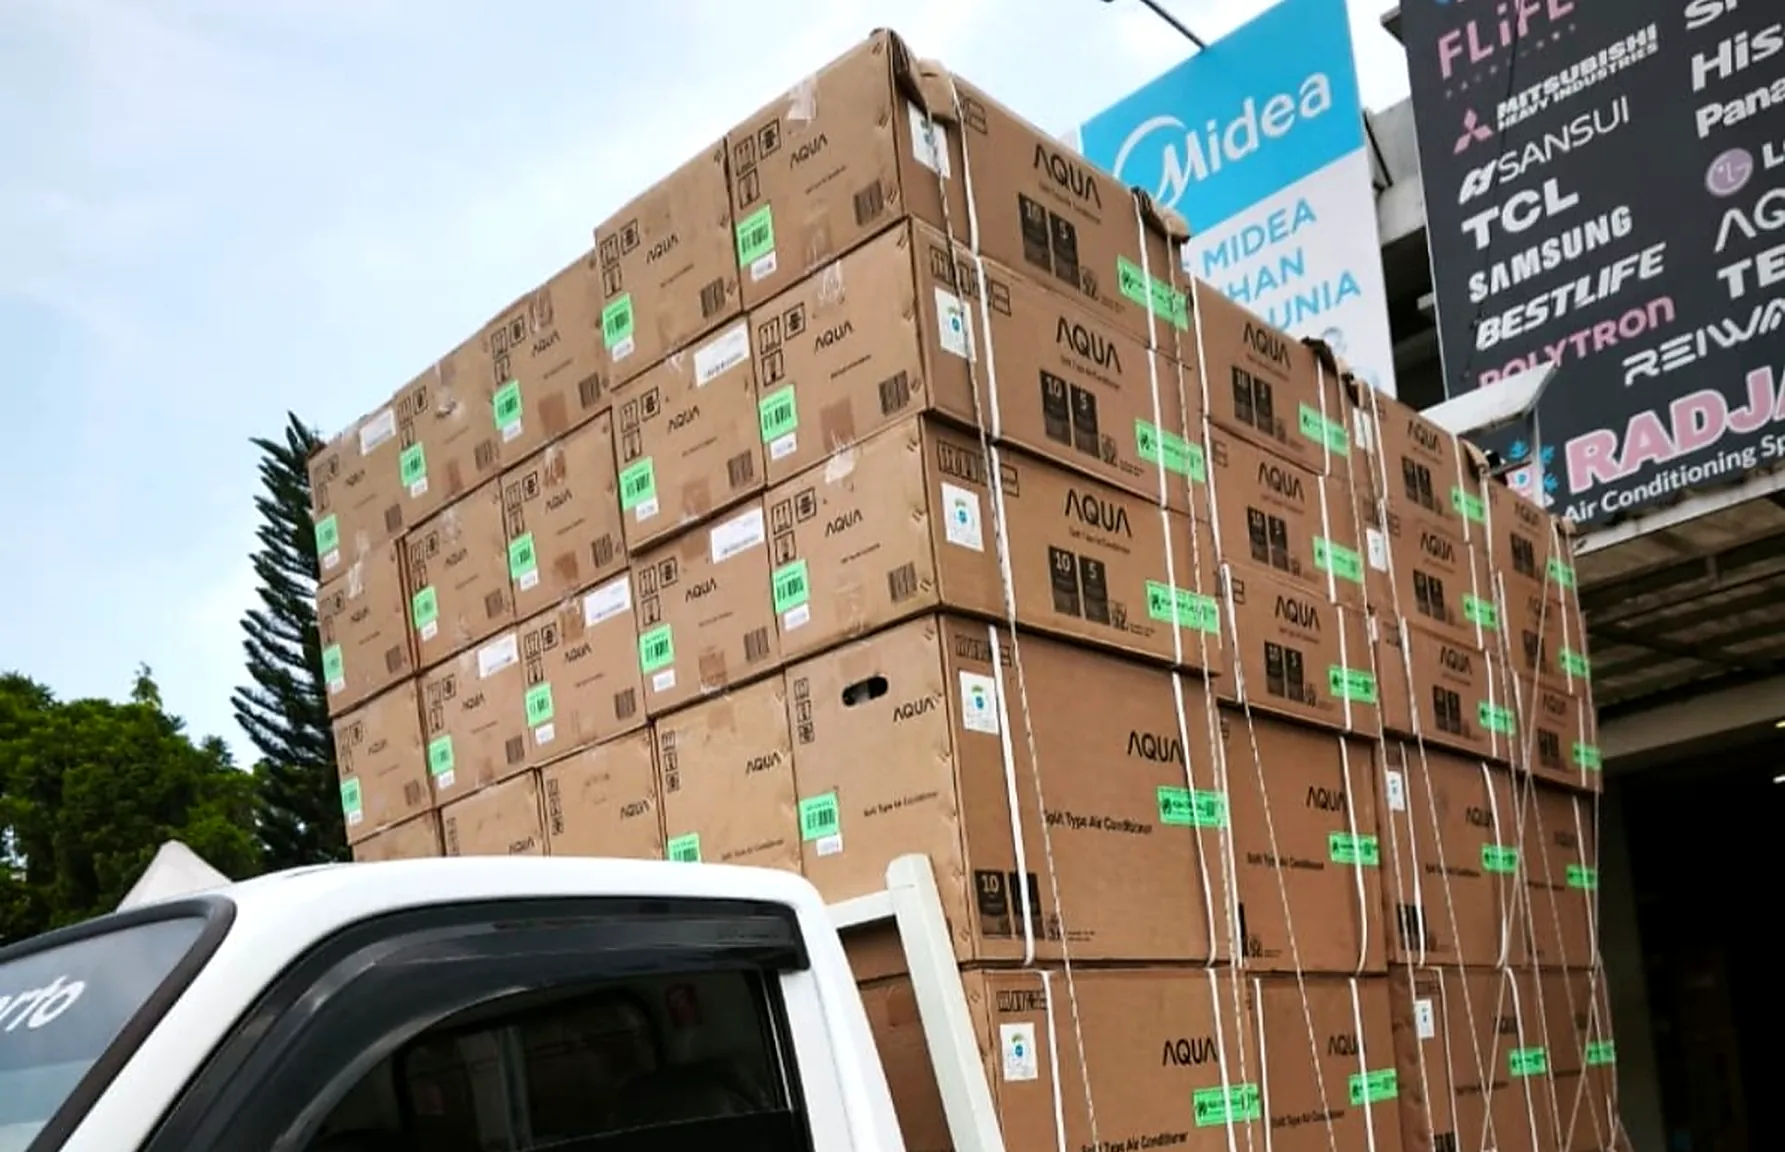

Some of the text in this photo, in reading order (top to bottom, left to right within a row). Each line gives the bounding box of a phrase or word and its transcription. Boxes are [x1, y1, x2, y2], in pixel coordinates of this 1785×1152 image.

[1684, 0, 1738, 30] S
[1497, 22, 1657, 118] MITSUBISHI
[1692, 23, 1784, 93] His
[1498, 41, 1659, 131] HEAVY INDUSTRIES
[1696, 77, 1785, 139] Pana
[790, 132, 828, 170] AQUA
[1113, 72, 1332, 210] Midea
[1497, 96, 1630, 183] SANSUI
[1762, 140, 1785, 170] L
[1034, 143, 1102, 209] AQUA
[1202, 197, 1318, 278] MIDEA
[1461, 177, 1580, 250] TCL
[645, 232, 681, 264] AQUA
[1469, 205, 1633, 303] SAMSUNG
[1227, 246, 1305, 304] HAN
[1476, 242, 1667, 351] BESTLIFE
[1268, 270, 1362, 332] UNIA
[814, 320, 855, 354] AQUA
[1056, 315, 1122, 375] AQUA
[1243, 322, 1292, 371] AQUA
[667, 405, 701, 433] AQUA
[1565, 365, 1785, 495] RADJ
[1258, 462, 1305, 501] AQUA
[1564, 501, 1598, 523] Air
[1601, 446, 1756, 512] Conditioning
[825, 509, 864, 538] AQUA
[1064, 488, 1133, 539] AQUA
[1055, 551, 1071, 572] 10
[684, 577, 718, 603] AQUA
[1274, 595, 1321, 631] AQUA
[892, 697, 936, 723] AQUA
[744, 751, 783, 776] AQUA
[1127, 730, 1185, 765] AQUA
[981, 875, 1000, 893] 10
[1162, 1037, 1219, 1066] AQUA
